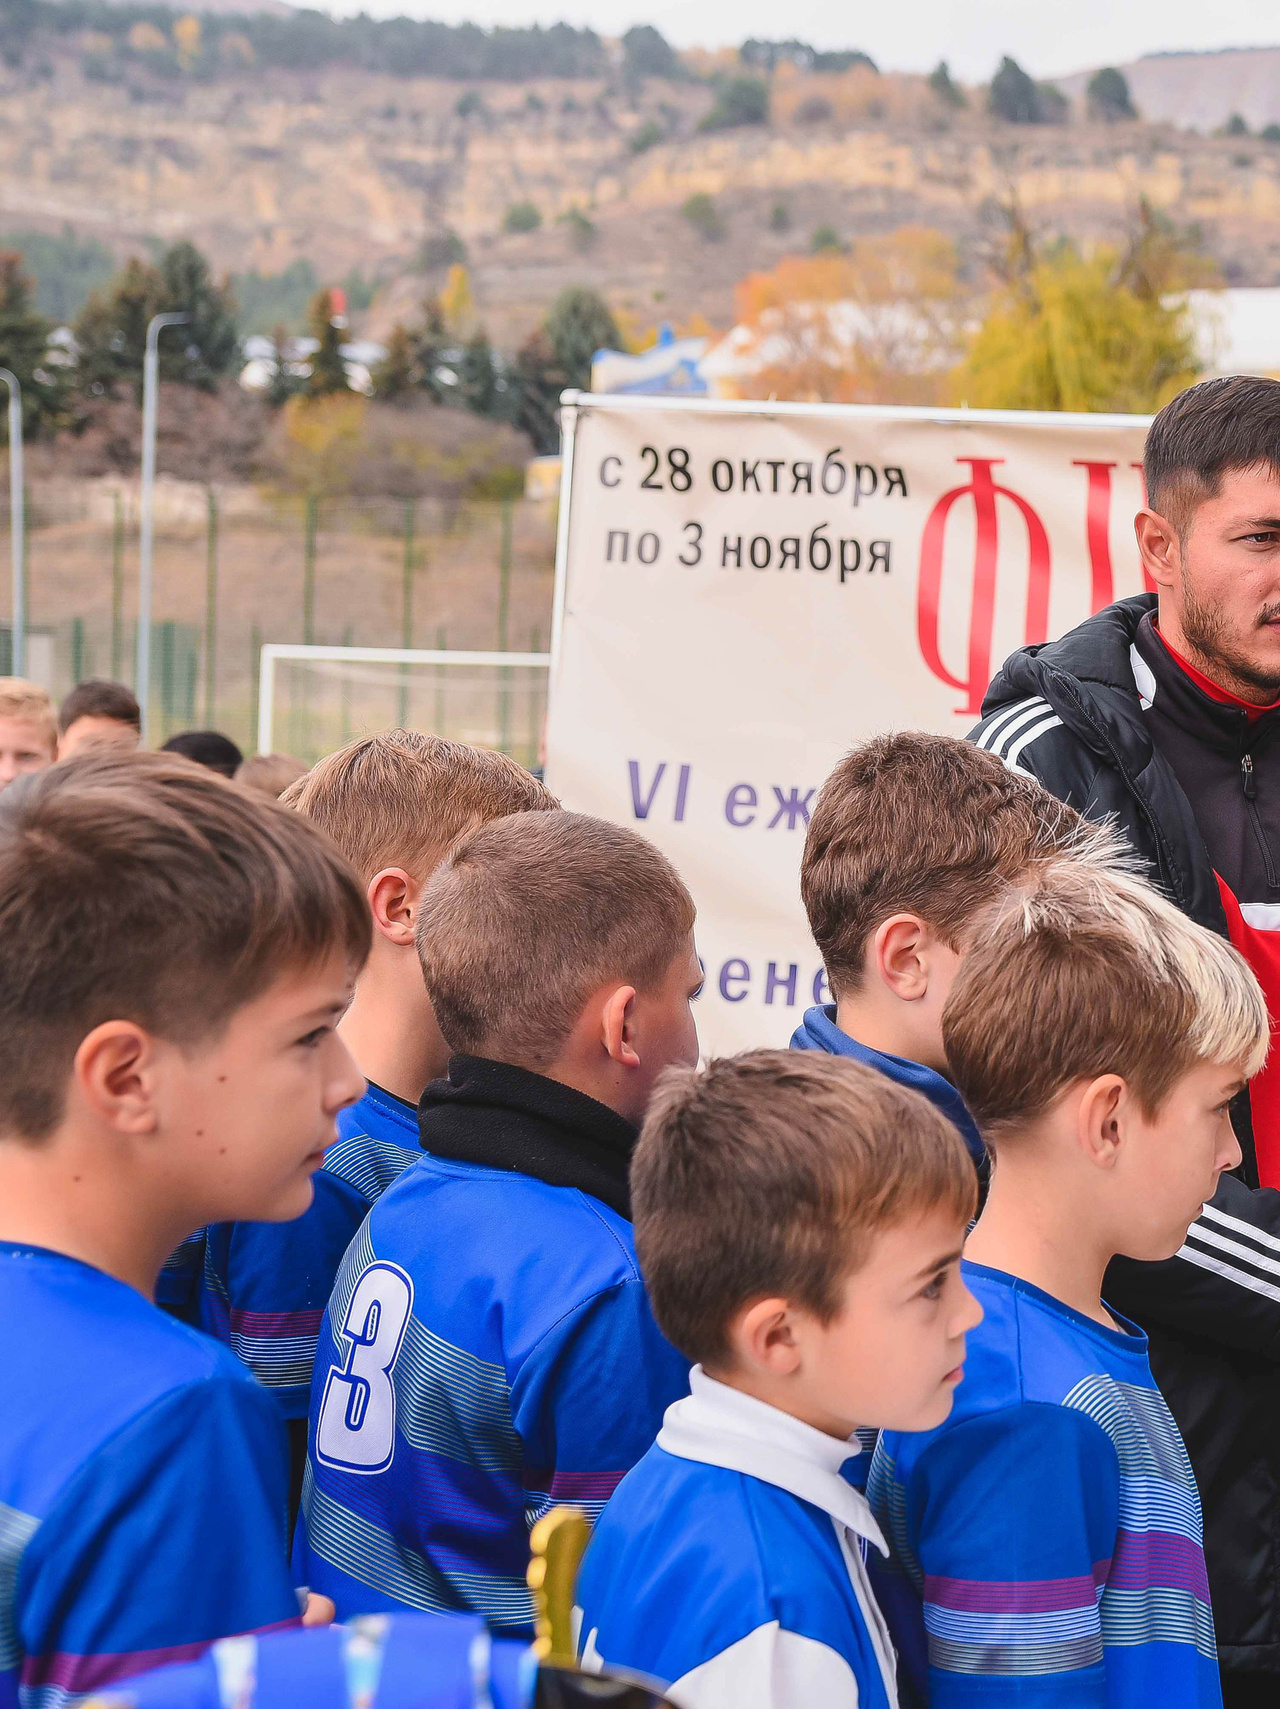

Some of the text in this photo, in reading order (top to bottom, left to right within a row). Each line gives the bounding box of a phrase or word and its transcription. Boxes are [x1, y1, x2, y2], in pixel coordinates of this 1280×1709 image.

[599, 446, 909, 507] с 28 октября
[606, 520, 892, 583] по 3 ноября
[627, 760, 691, 822] VI
[317, 1258, 414, 1475] 3
